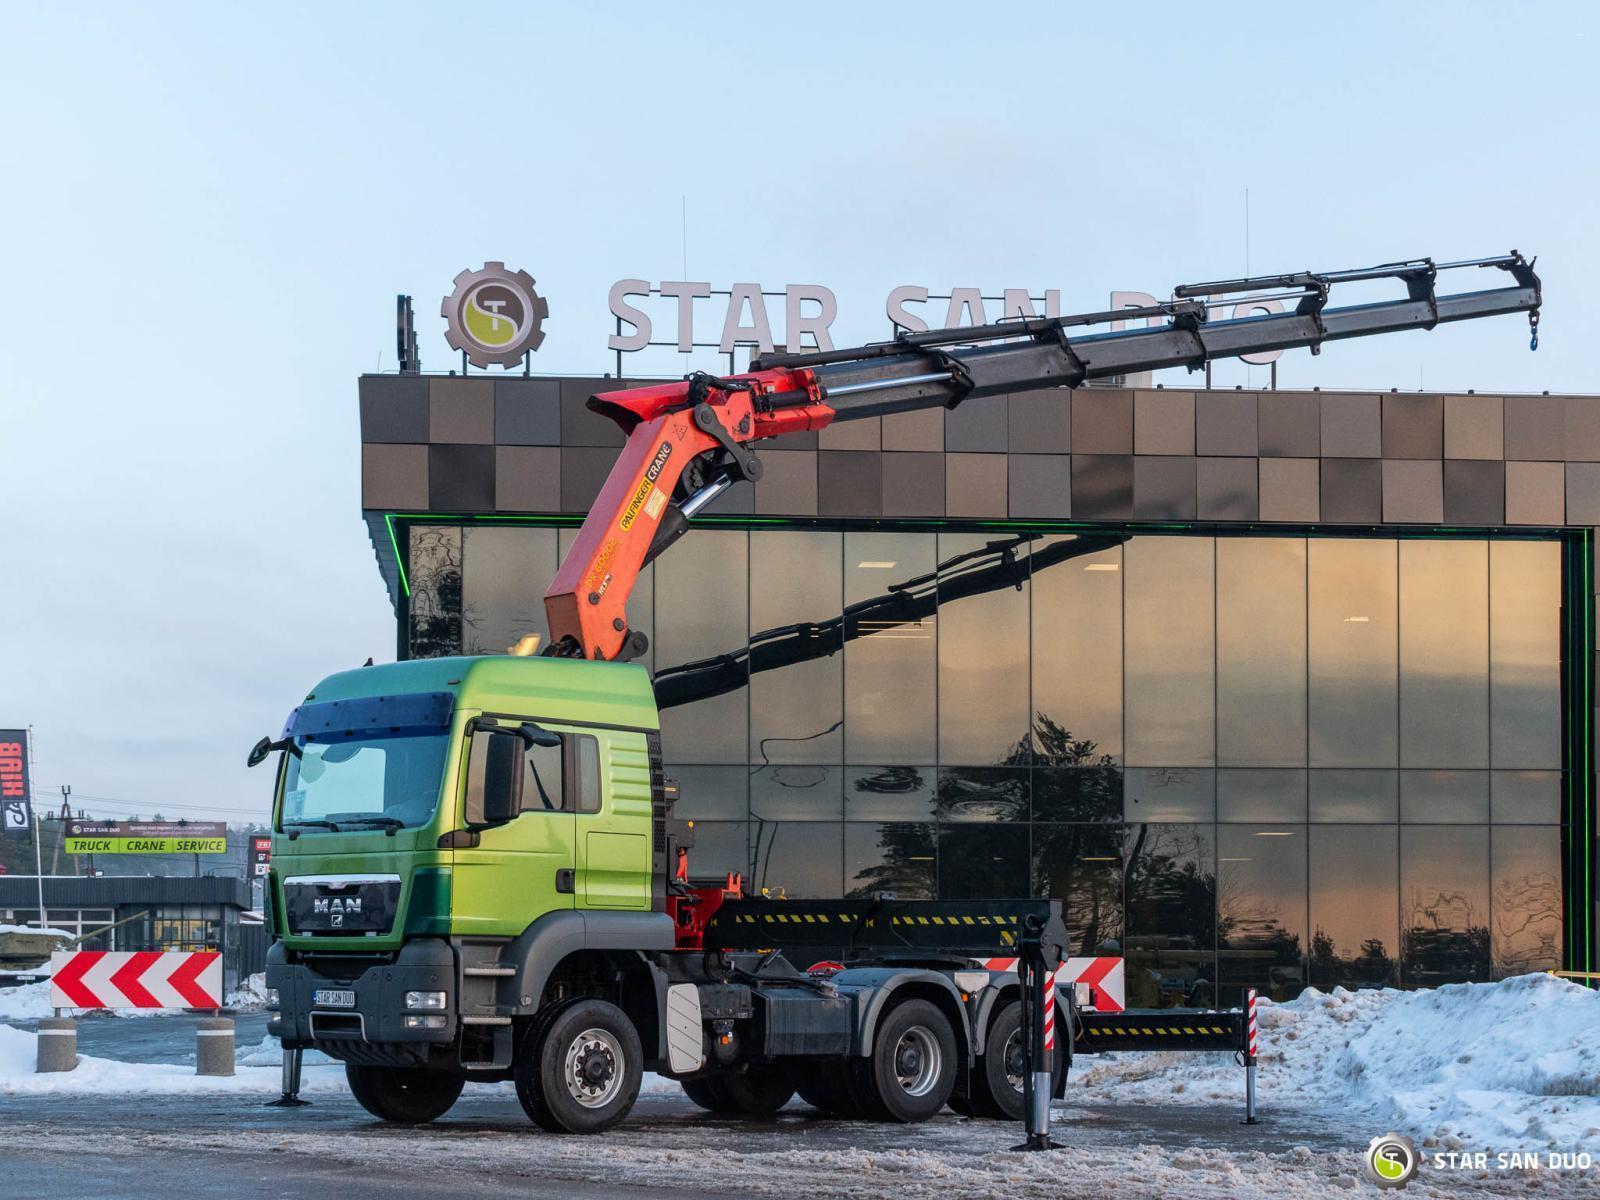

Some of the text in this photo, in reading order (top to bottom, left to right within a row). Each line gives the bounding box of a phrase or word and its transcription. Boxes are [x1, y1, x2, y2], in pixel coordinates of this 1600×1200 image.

[608, 278, 838, 353] STAR
[621, 480, 651, 529] PALFINGER
[647, 443, 671, 481] CRANE
[0, 743, 24, 795] HIAB
[73, 840, 223, 851] TRUCK CRANE SERVICE
[314, 898, 361, 913] MAN
[317, 991, 354, 1004] STAR SAN DUO
